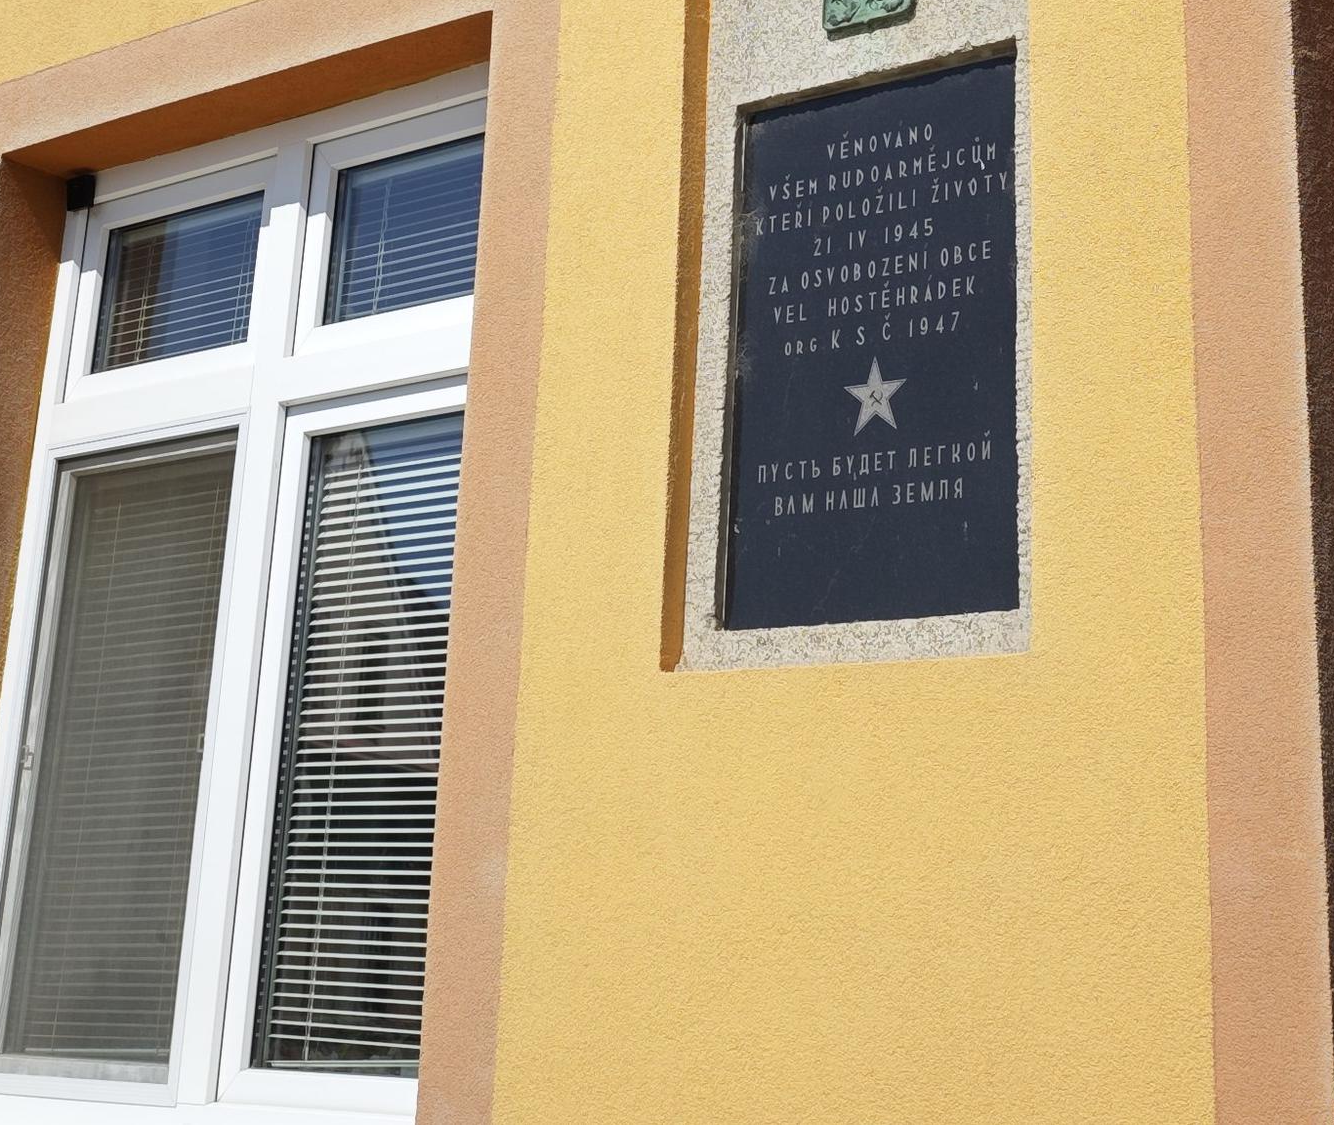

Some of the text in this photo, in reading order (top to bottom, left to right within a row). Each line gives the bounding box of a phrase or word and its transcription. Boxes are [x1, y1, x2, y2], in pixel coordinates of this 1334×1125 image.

[826, 121, 933, 161] VĚNOVÁNO
[769, 136, 997, 202] VŠEM RUDOARMĚJCŮM
[822, 186, 917, 224] POLOŽILI
[930, 171, 1008, 204] ŽIVOTY
[813, 217, 934, 257] 21 IV 1945
[768, 239, 993, 296] ZA OSVOBOZENÍ OBCE
[773, 275, 976, 325] VEL HOSTĚHRÁDEK
[784, 311, 961, 357] ORG K S Č 1947
[757, 430, 992, 484] ПУСТЬ БУДЕТ ЛЕГКОЙ
[774, 477, 964, 517] ВАМ НАША ЗЕМЛЯ
